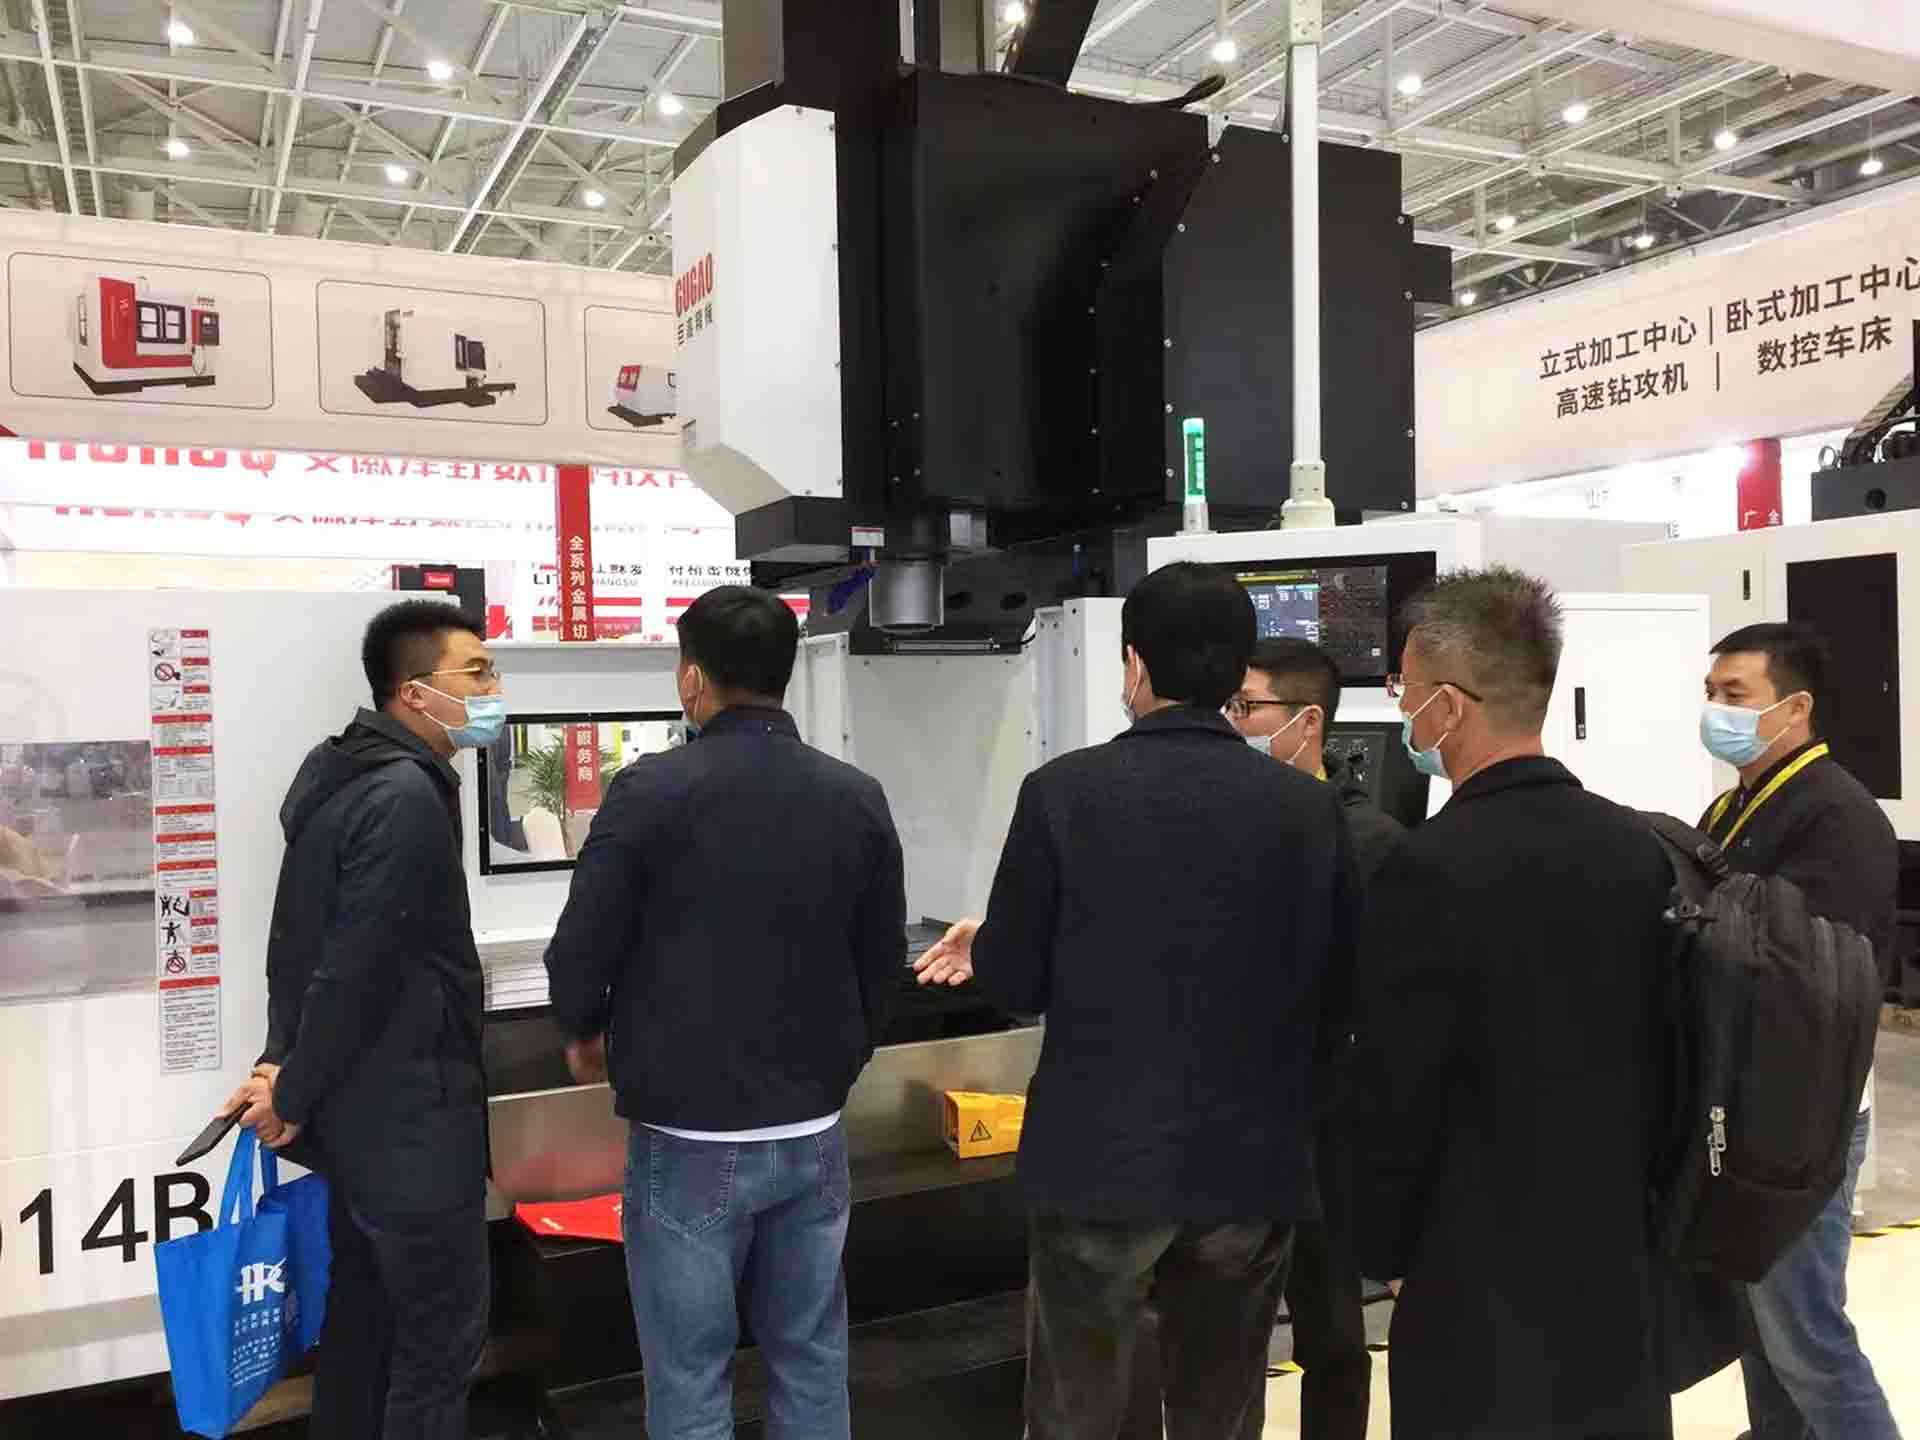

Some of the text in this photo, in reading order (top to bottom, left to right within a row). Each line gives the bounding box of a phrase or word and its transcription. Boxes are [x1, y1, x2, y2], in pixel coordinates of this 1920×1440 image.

[1726, 256, 1920, 334] 卧式加工中心
[1539, 315, 1697, 380] 立式加工中心
[1756, 315, 1893, 376] 数控车床
[1555, 362, 1689, 419] 高速钻攻机
[576, 723, 593, 784] 服务商
[0, 1171, 213, 1275] 14B
